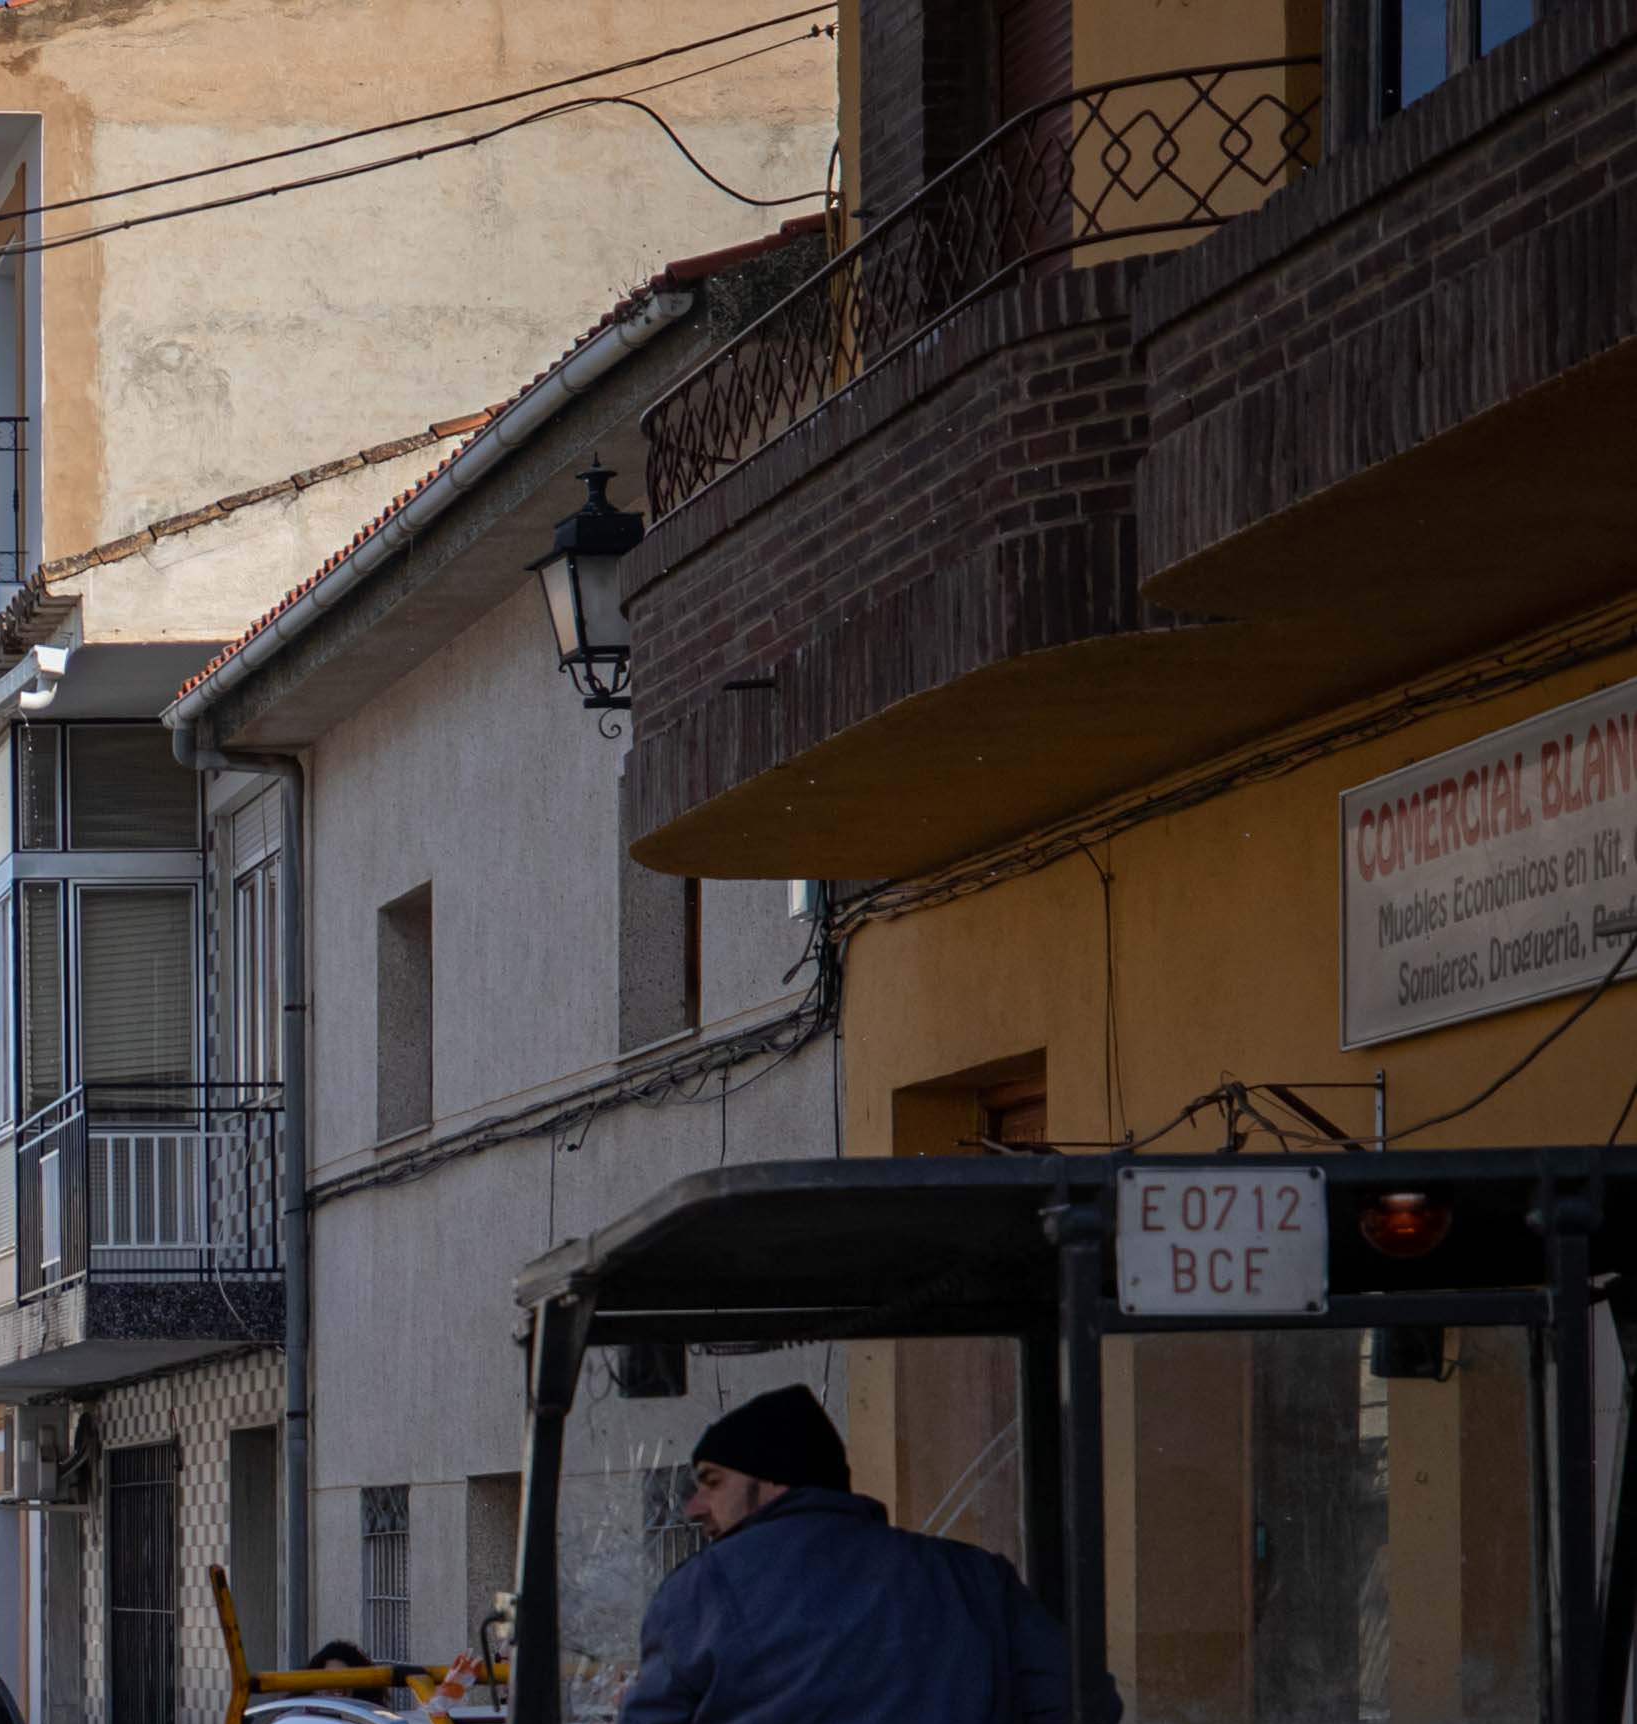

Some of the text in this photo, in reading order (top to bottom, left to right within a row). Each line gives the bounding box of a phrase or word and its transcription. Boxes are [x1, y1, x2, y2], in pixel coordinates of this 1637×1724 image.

[1357, 713, 1637, 881] COMERCIAL BLAN
[1379, 889, 1446, 948] Muebles
[1454, 852, 1557, 922] Económicos
[1564, 847, 1587, 888] en
[1593, 831, 1627, 882] Kit,
[1399, 953, 1485, 1007] Somieres,
[1490, 911, 1587, 984] Droguería,
[1170, 1246, 1270, 1296] BCF
